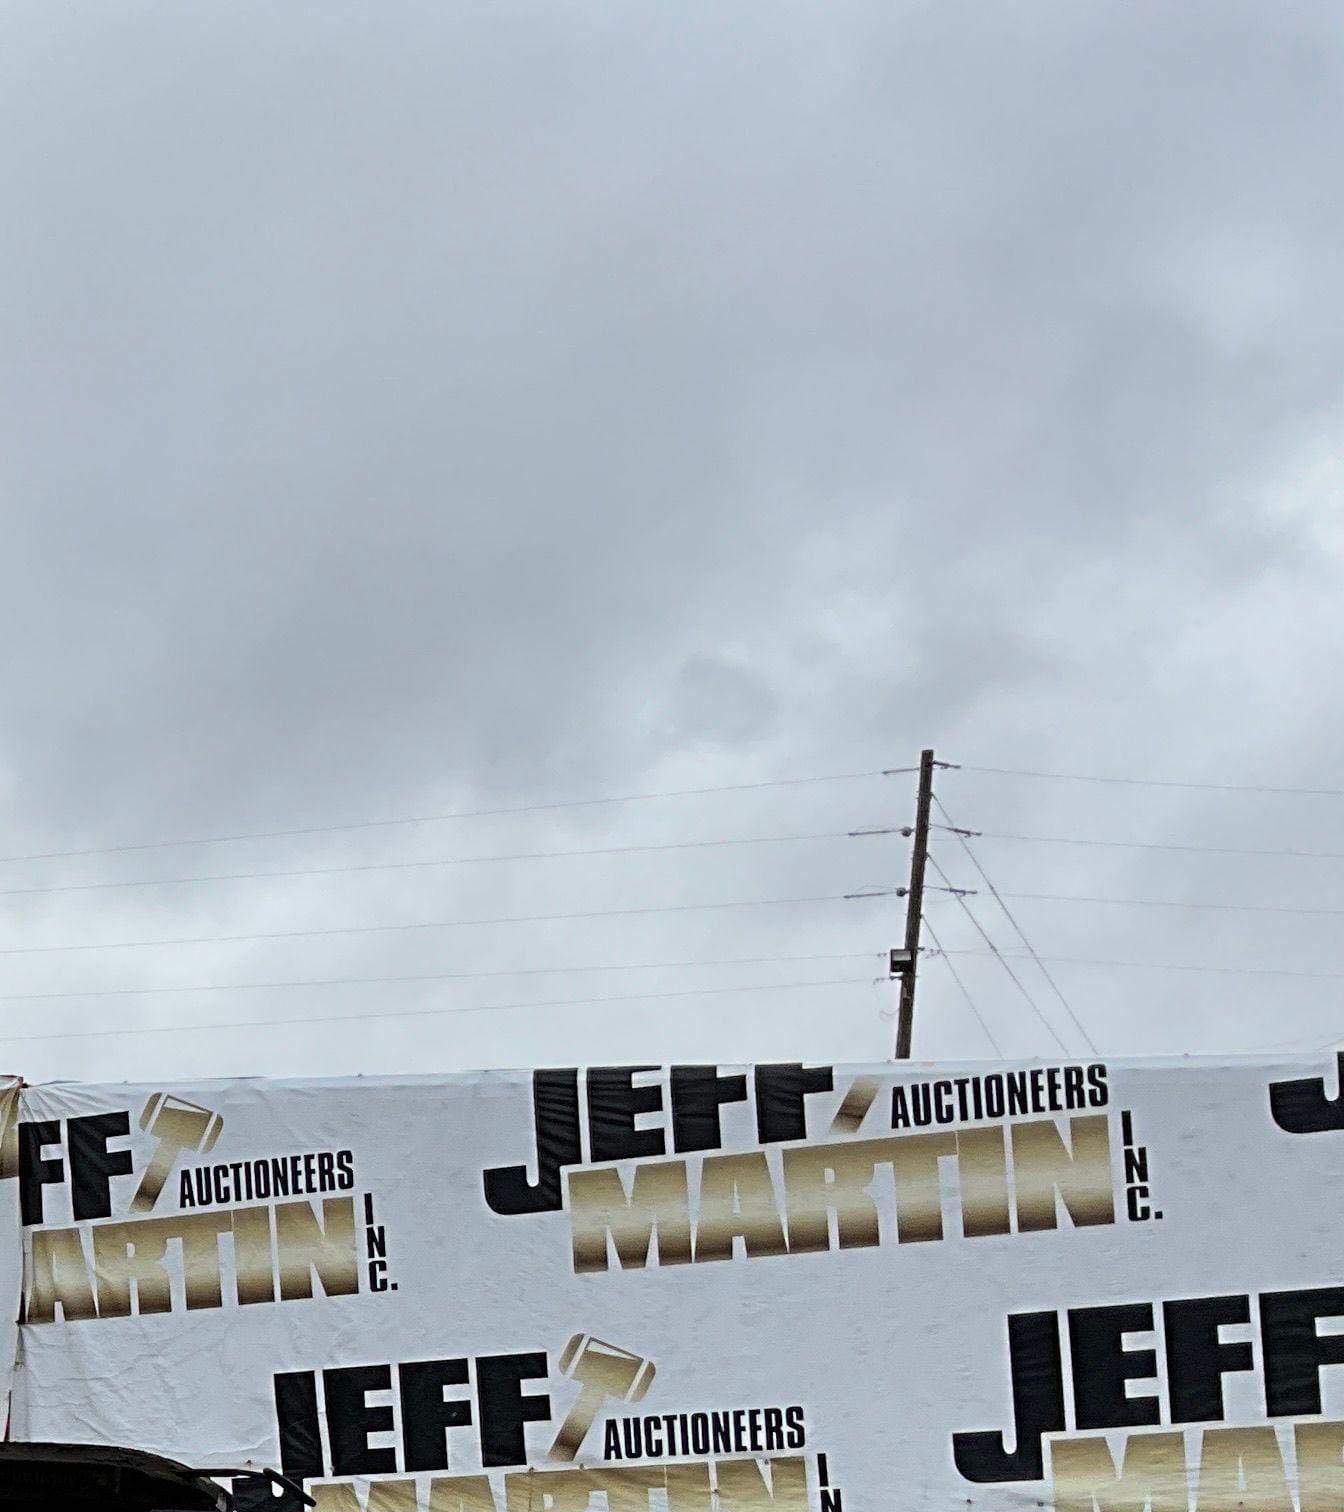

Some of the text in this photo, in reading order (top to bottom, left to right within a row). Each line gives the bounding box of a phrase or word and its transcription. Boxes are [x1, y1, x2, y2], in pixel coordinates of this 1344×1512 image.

[18, 1111, 134, 1227] FF
[179, 1150, 354, 1209] AUCTIONEERS
[483, 1062, 1109, 1216] JEFF AUCTIONEERS
[567, 1114, 1115, 1274] MARTIN
[25, 1195, 359, 1325] ARTIN
[603, 1406, 806, 1461] AUCTIONEERS
[953, 1286, 1344, 1484] JEFF
